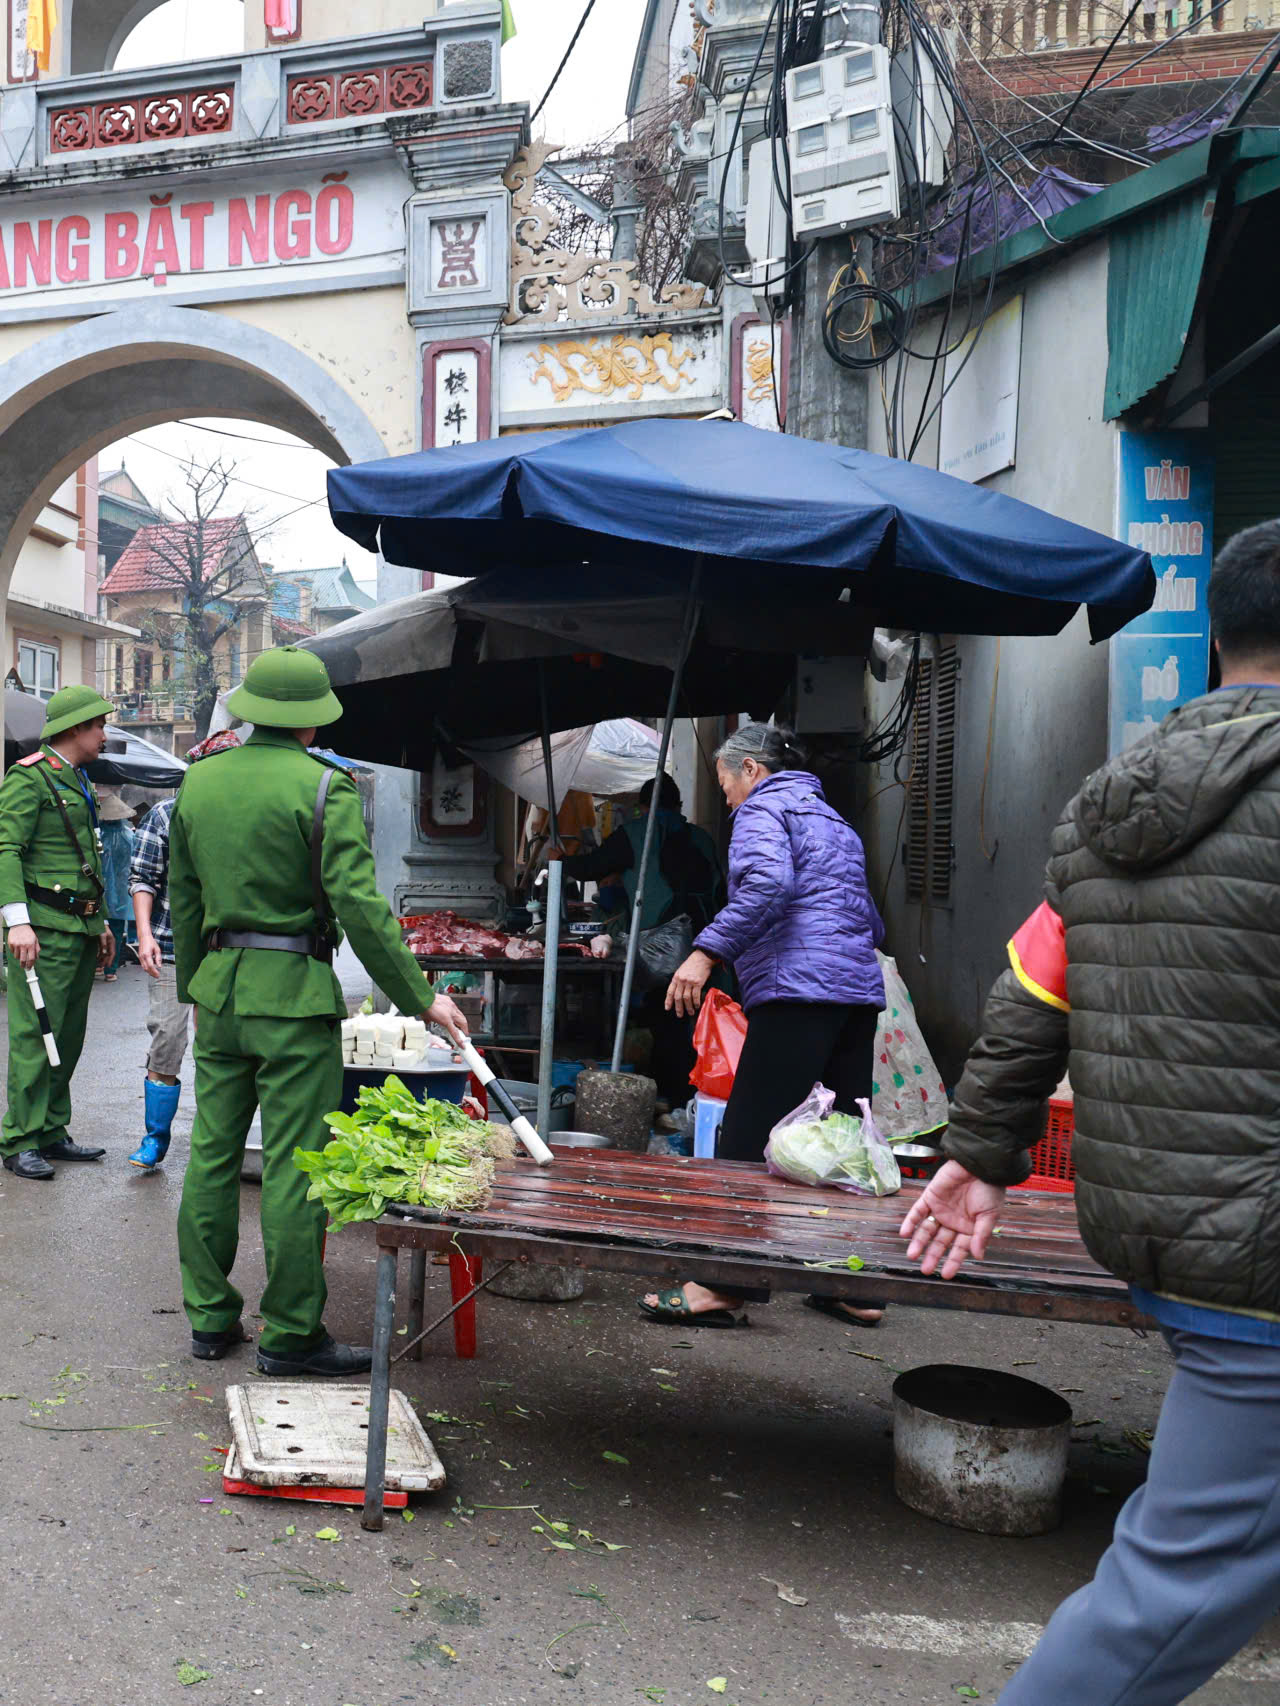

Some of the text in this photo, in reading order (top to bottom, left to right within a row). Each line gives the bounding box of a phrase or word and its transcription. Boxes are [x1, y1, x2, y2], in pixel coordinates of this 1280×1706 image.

[104, 191, 214, 287] BẶT
[228, 170, 355, 267] NGÕ
[1144, 459, 1190, 500] VĂN
[1128, 514, 1204, 556] PHÒNG
[1152, 564, 1197, 612] ẨM
